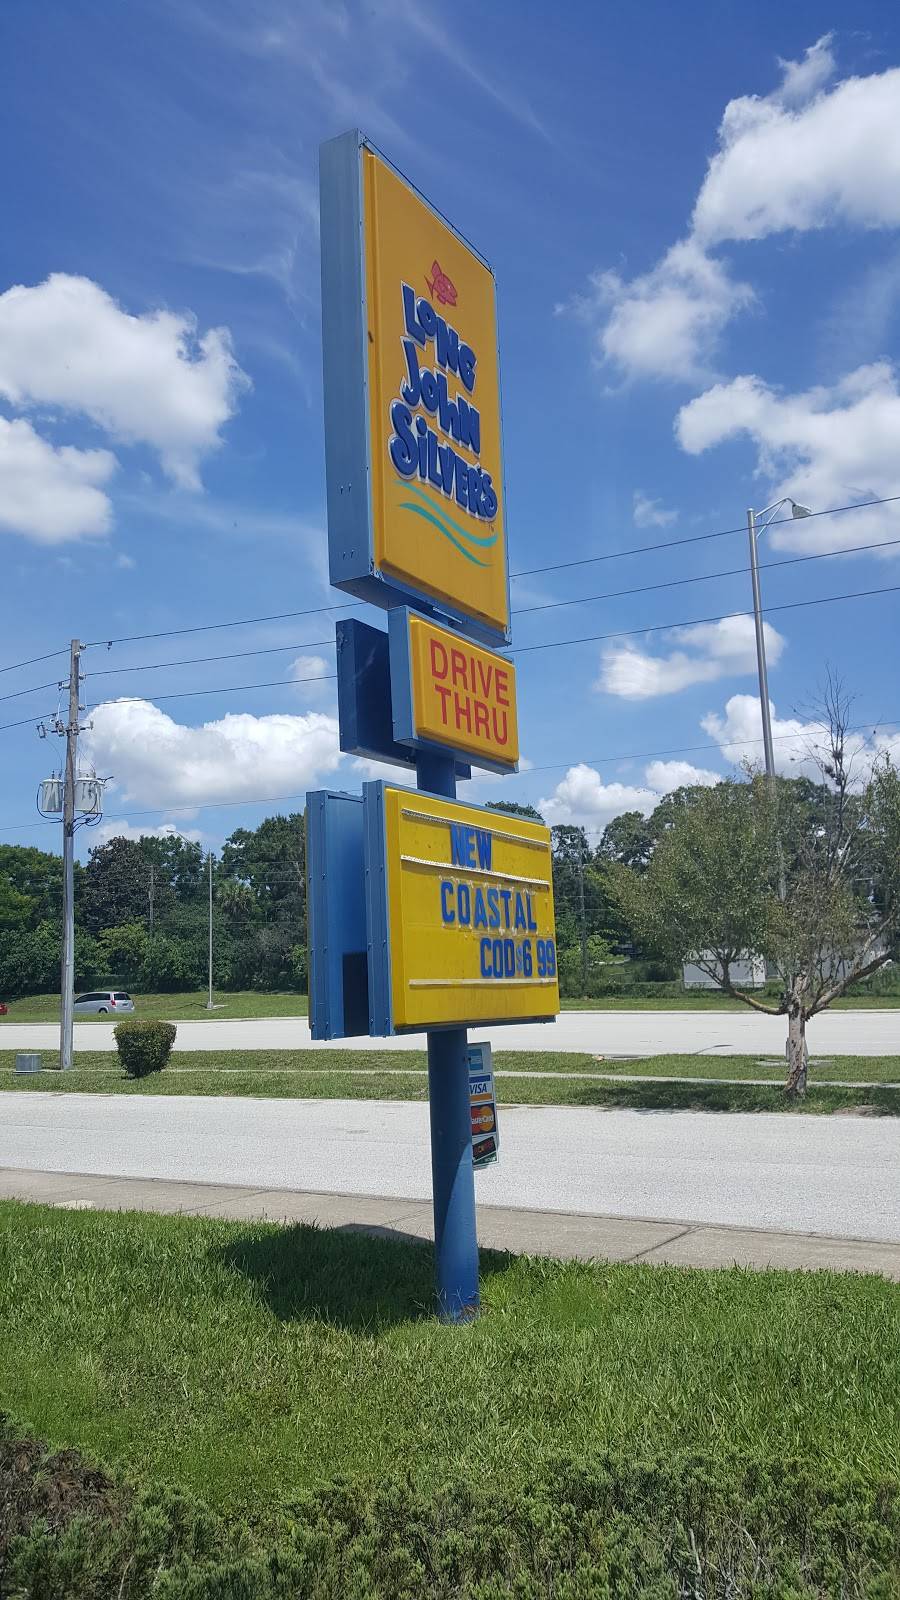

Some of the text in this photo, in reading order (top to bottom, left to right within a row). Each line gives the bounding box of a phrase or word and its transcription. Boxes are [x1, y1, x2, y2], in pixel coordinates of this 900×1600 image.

[430, 638, 510, 707] DRIVE
[434, 684, 508, 745] THRU
[450, 825, 492, 871] NEW
[440, 881, 537, 932] COASTAL
[469, 1083, 488, 1095] VISA
